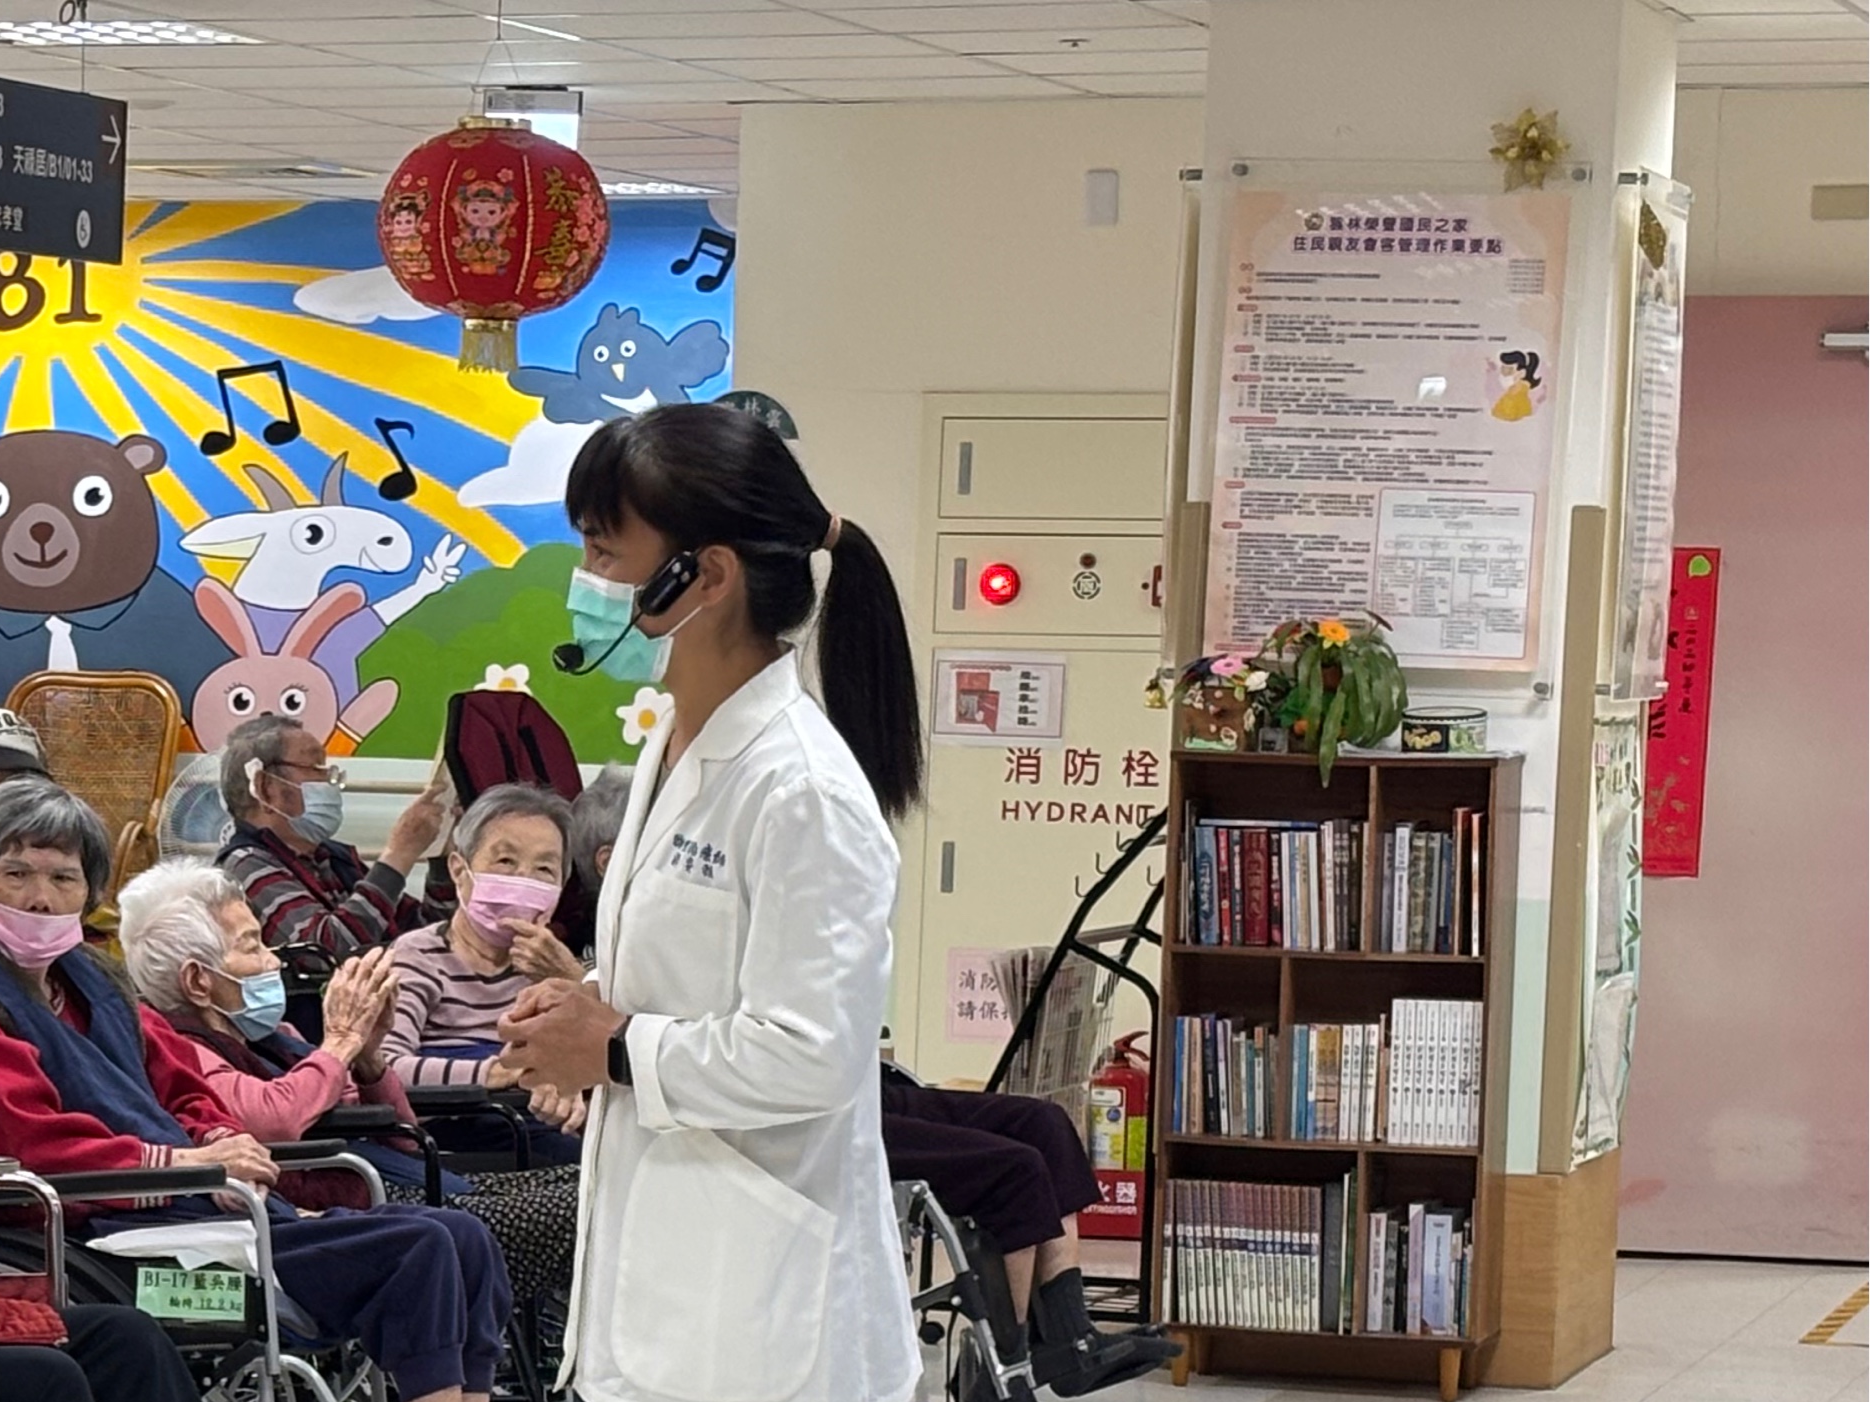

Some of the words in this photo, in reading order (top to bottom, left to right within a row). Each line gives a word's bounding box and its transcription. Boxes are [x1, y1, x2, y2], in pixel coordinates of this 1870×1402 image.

[1004, 747, 1160, 788] 消防栓
[1001, 800, 1156, 826] HYDRANT
[956, 1000, 1008, 1021] 請保
